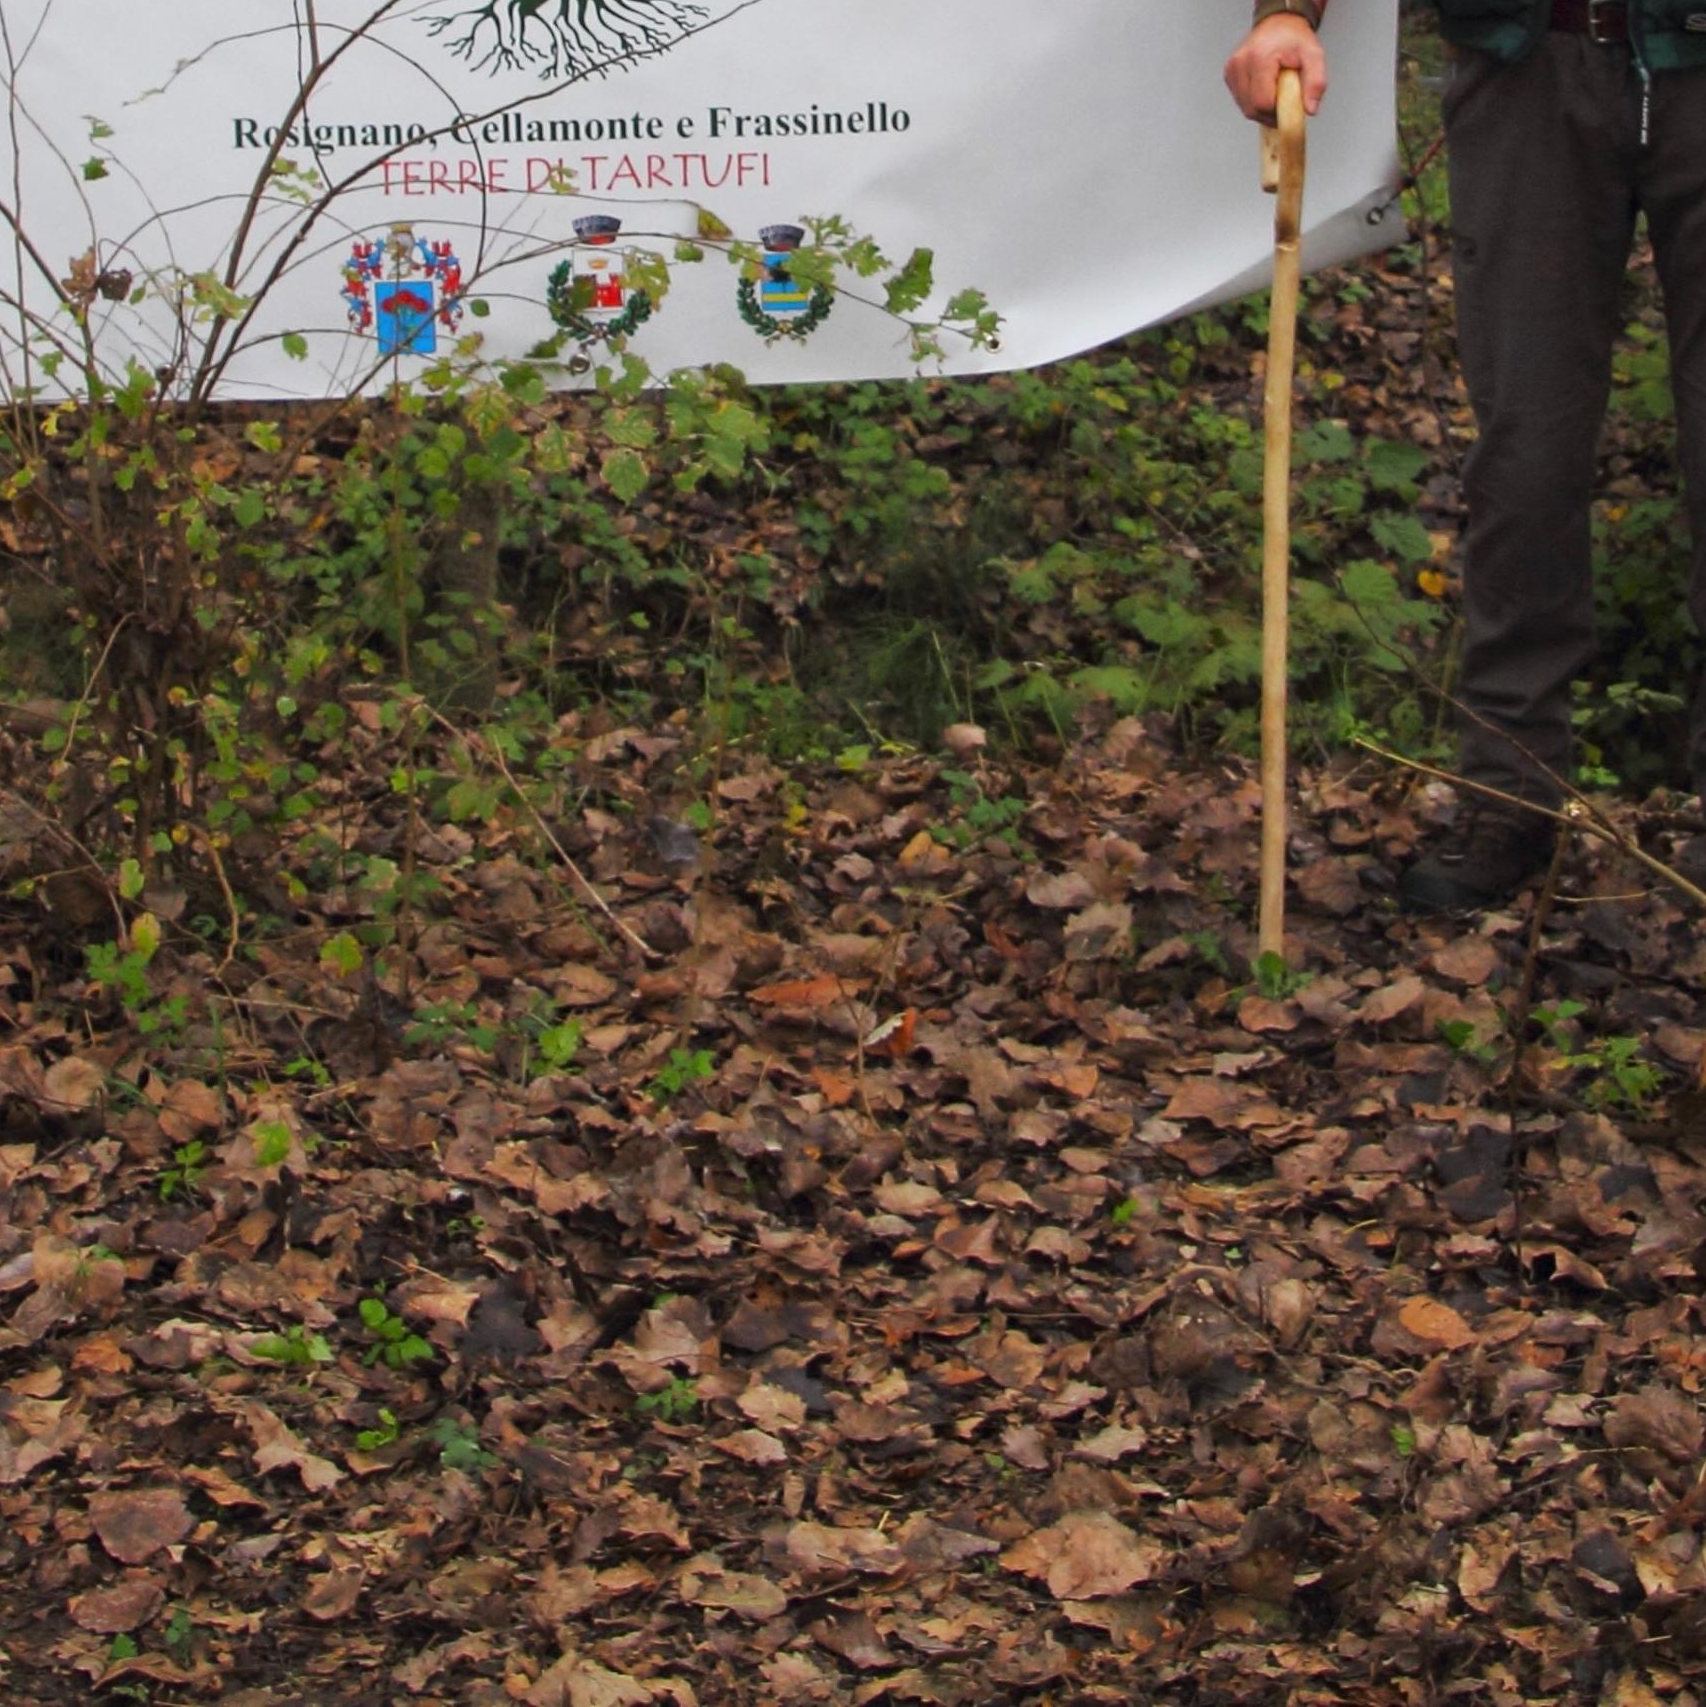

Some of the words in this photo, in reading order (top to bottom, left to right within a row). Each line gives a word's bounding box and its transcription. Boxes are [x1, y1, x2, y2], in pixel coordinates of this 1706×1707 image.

[452, 111, 664, 144] Cellamonte
[676, 114, 694, 139] e
[708, 102, 911, 138] Frassinello
[380, 158, 509, 196] TERRE
[581, 152, 770, 191] TARTUFI
